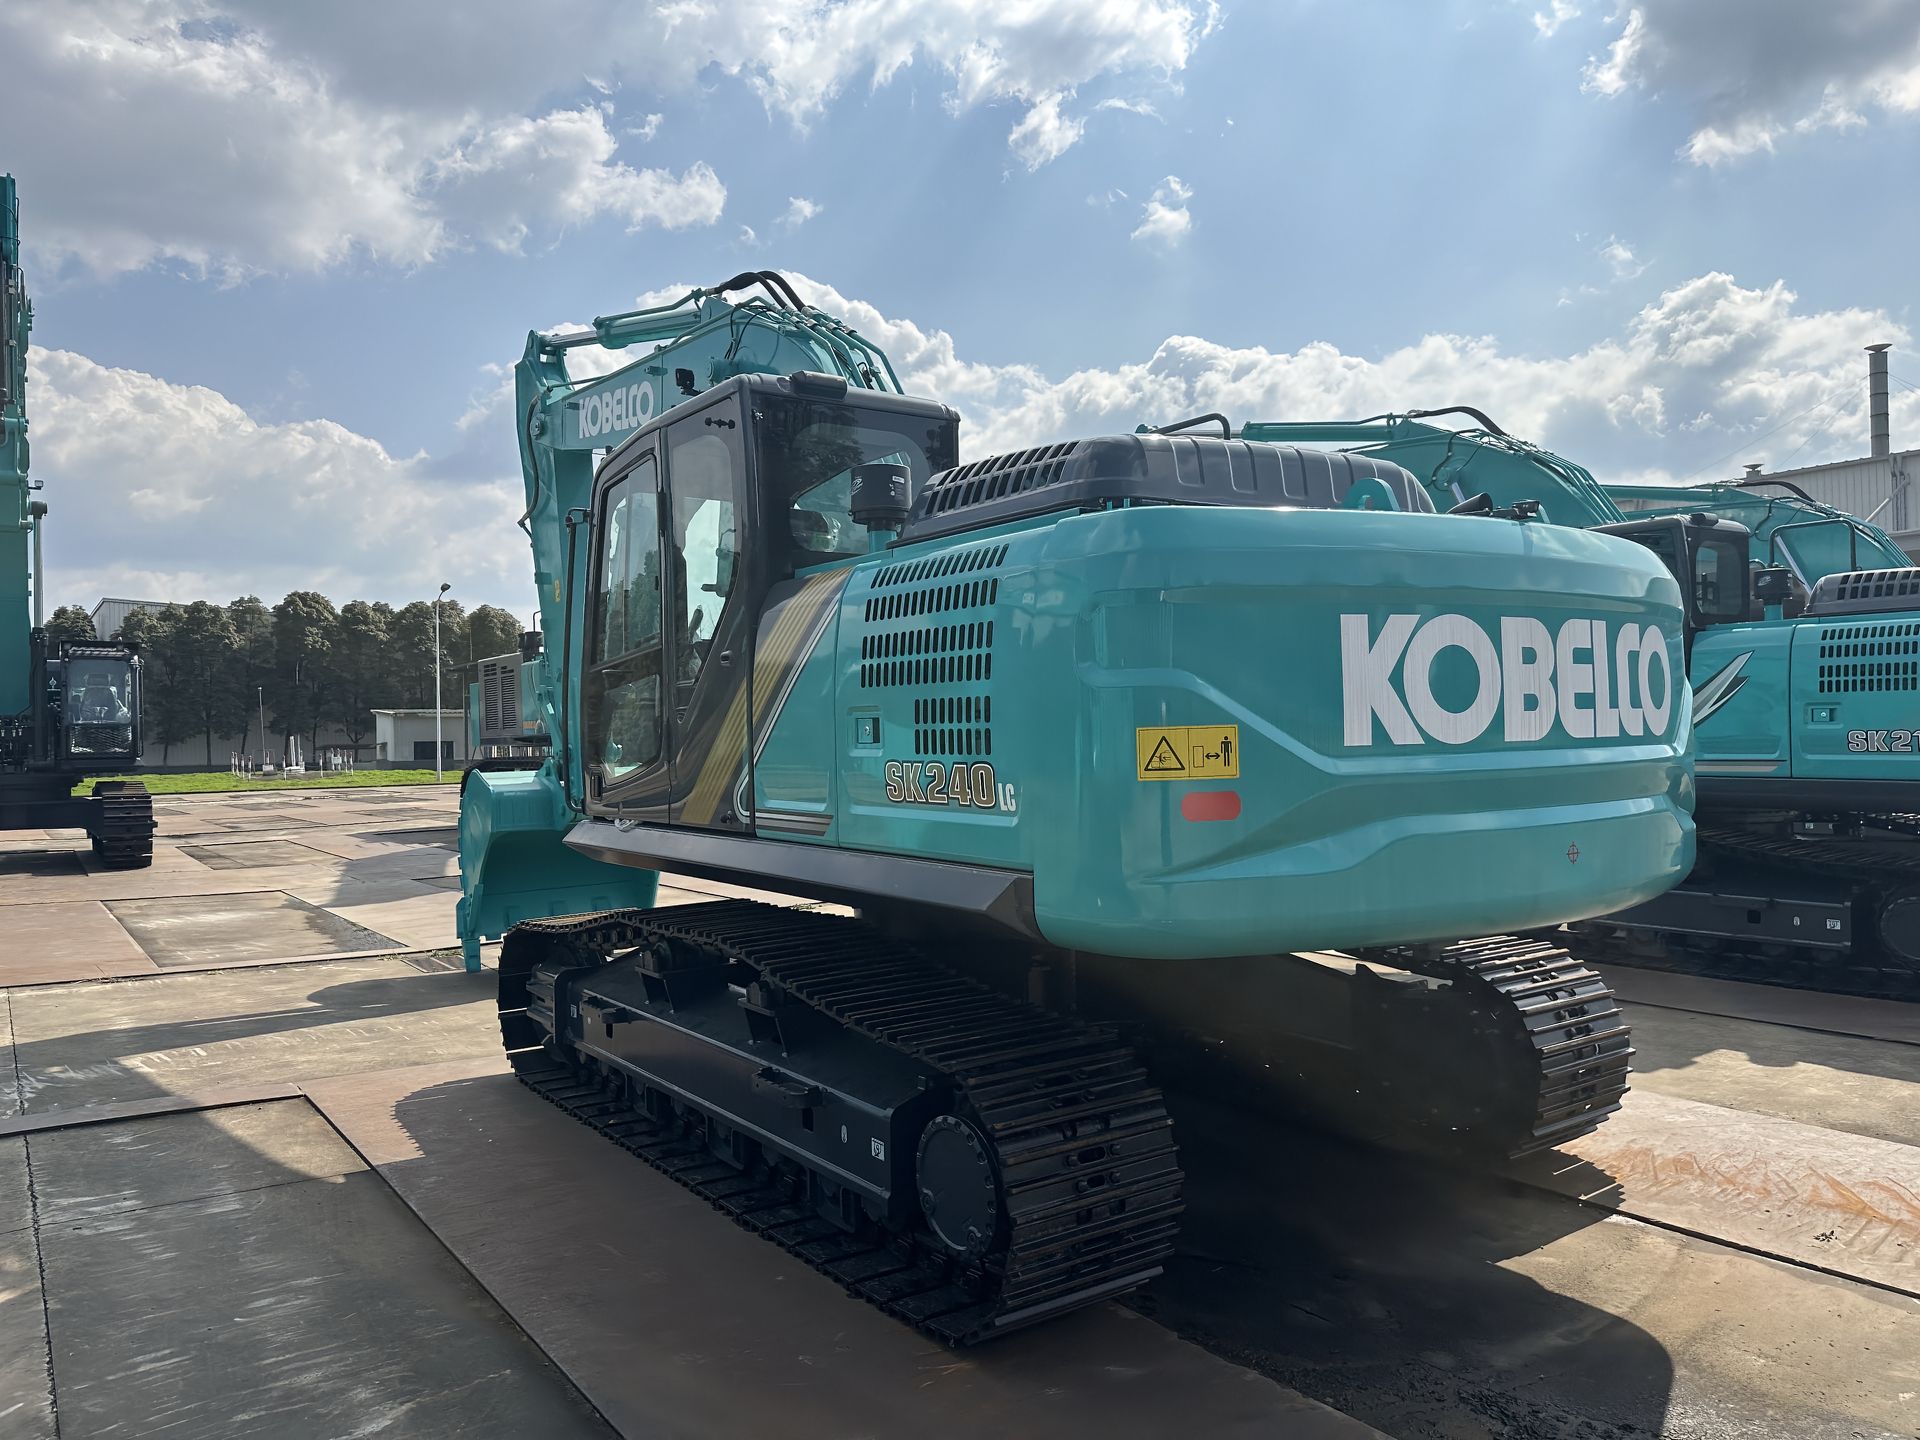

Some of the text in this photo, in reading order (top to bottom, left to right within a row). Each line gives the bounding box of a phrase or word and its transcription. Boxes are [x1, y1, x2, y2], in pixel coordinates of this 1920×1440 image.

[579, 381, 654, 439] KOBELCO
[1340, 613, 1672, 746] KOBELCO
[885, 761, 996, 807] SK240
